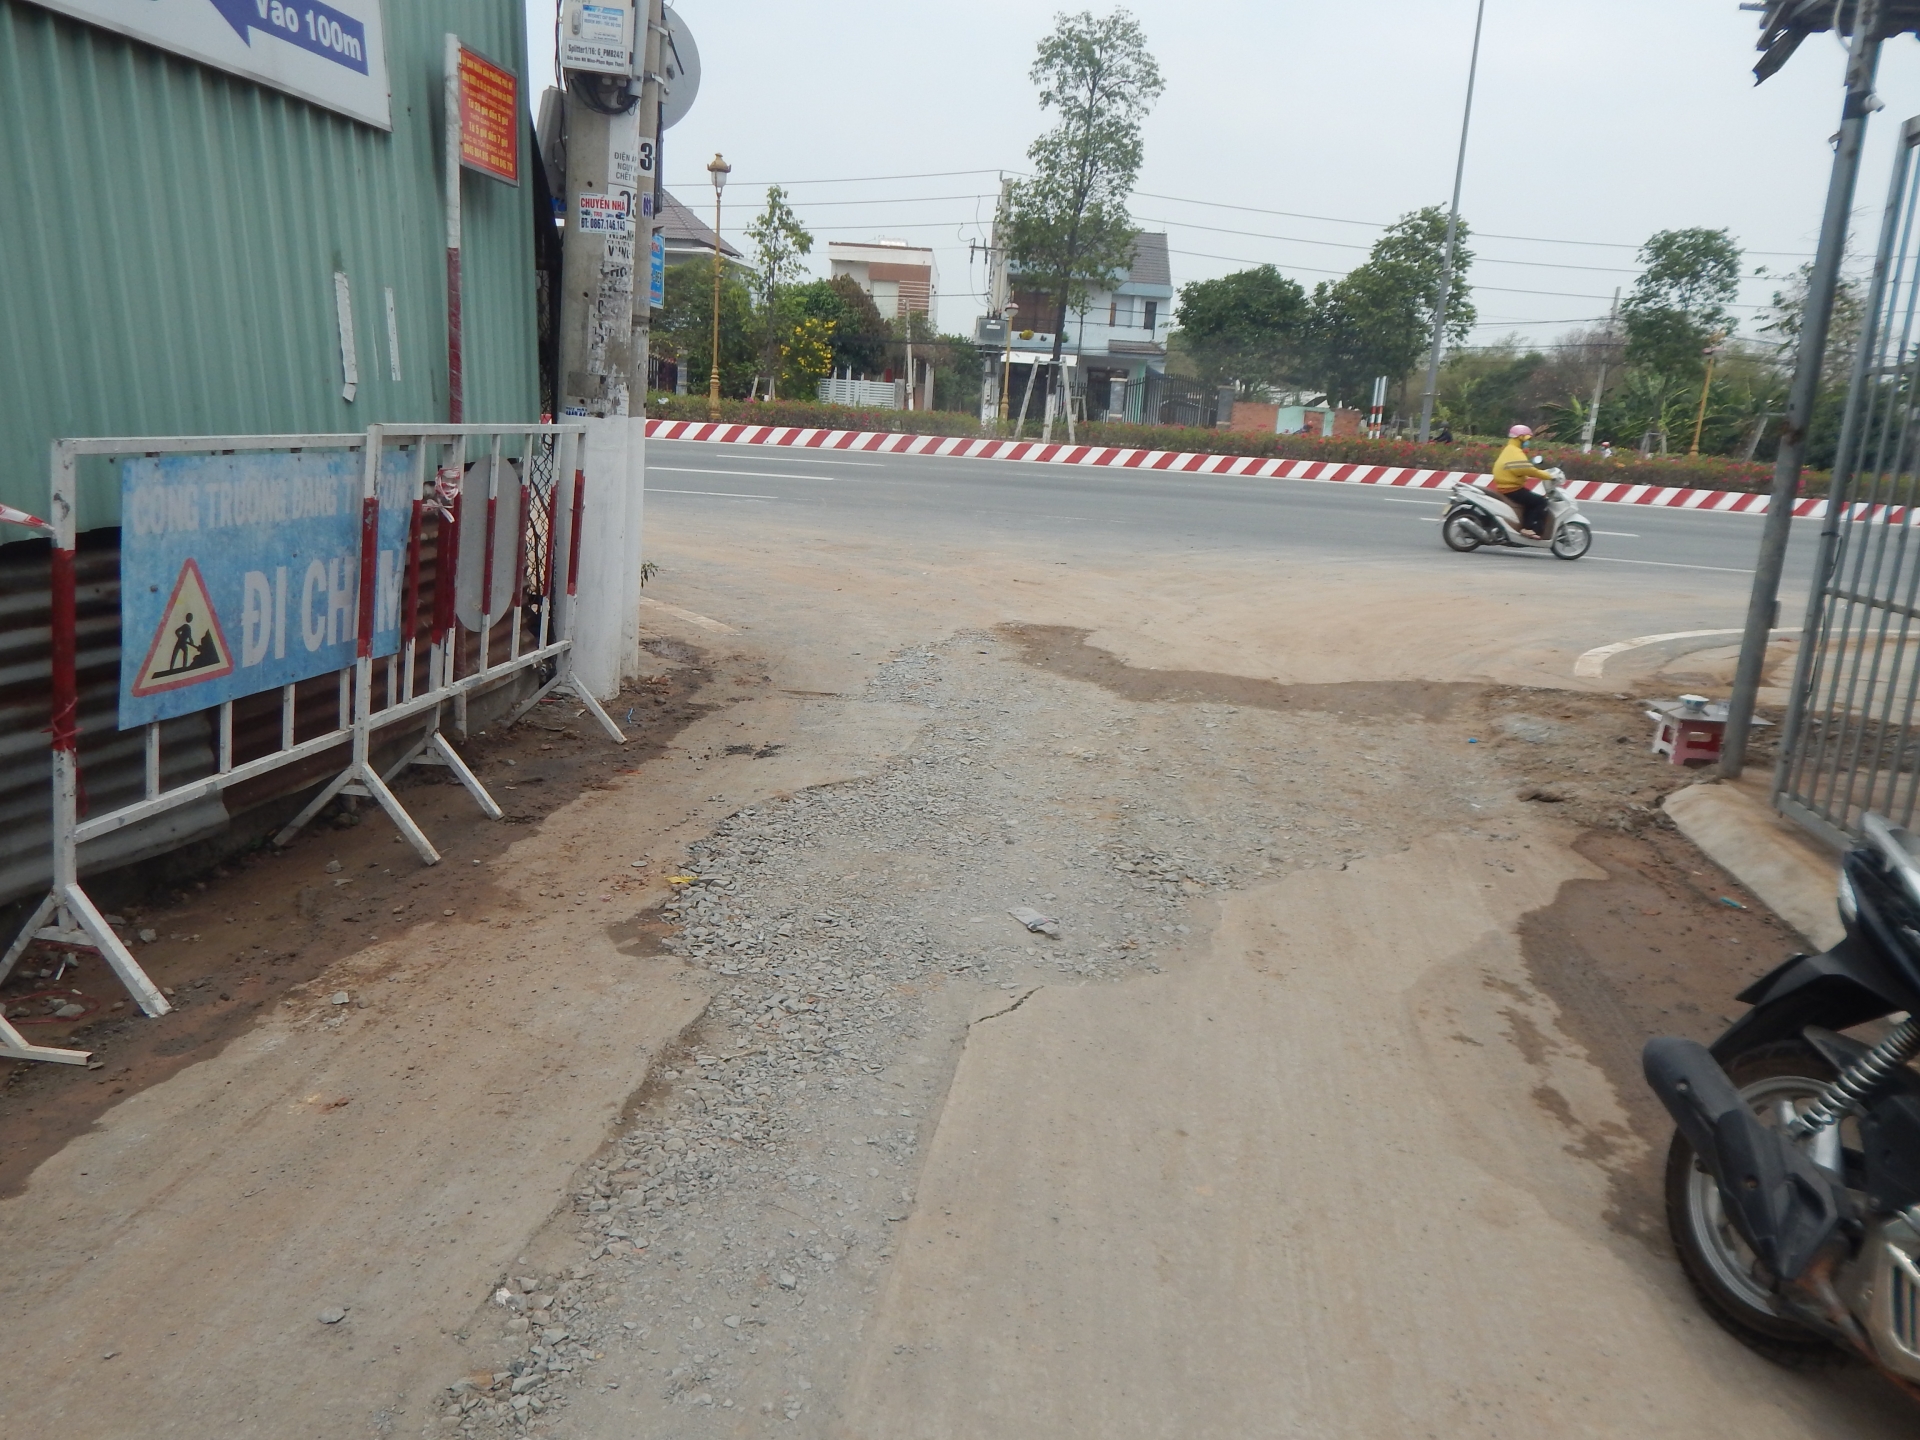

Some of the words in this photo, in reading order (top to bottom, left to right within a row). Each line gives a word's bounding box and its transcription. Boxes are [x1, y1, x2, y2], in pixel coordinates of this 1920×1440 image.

[305, 9, 362, 61] 100m
[614, 151, 631, 162] ĐIỆN
[615, 171, 631, 180] CHẾT
[580, 195, 610, 210] CHUYỂN
[612, 199, 625, 211] NHÀ
[241, 566, 287, 668] ĐI
[301, 550, 401, 652] CHM
